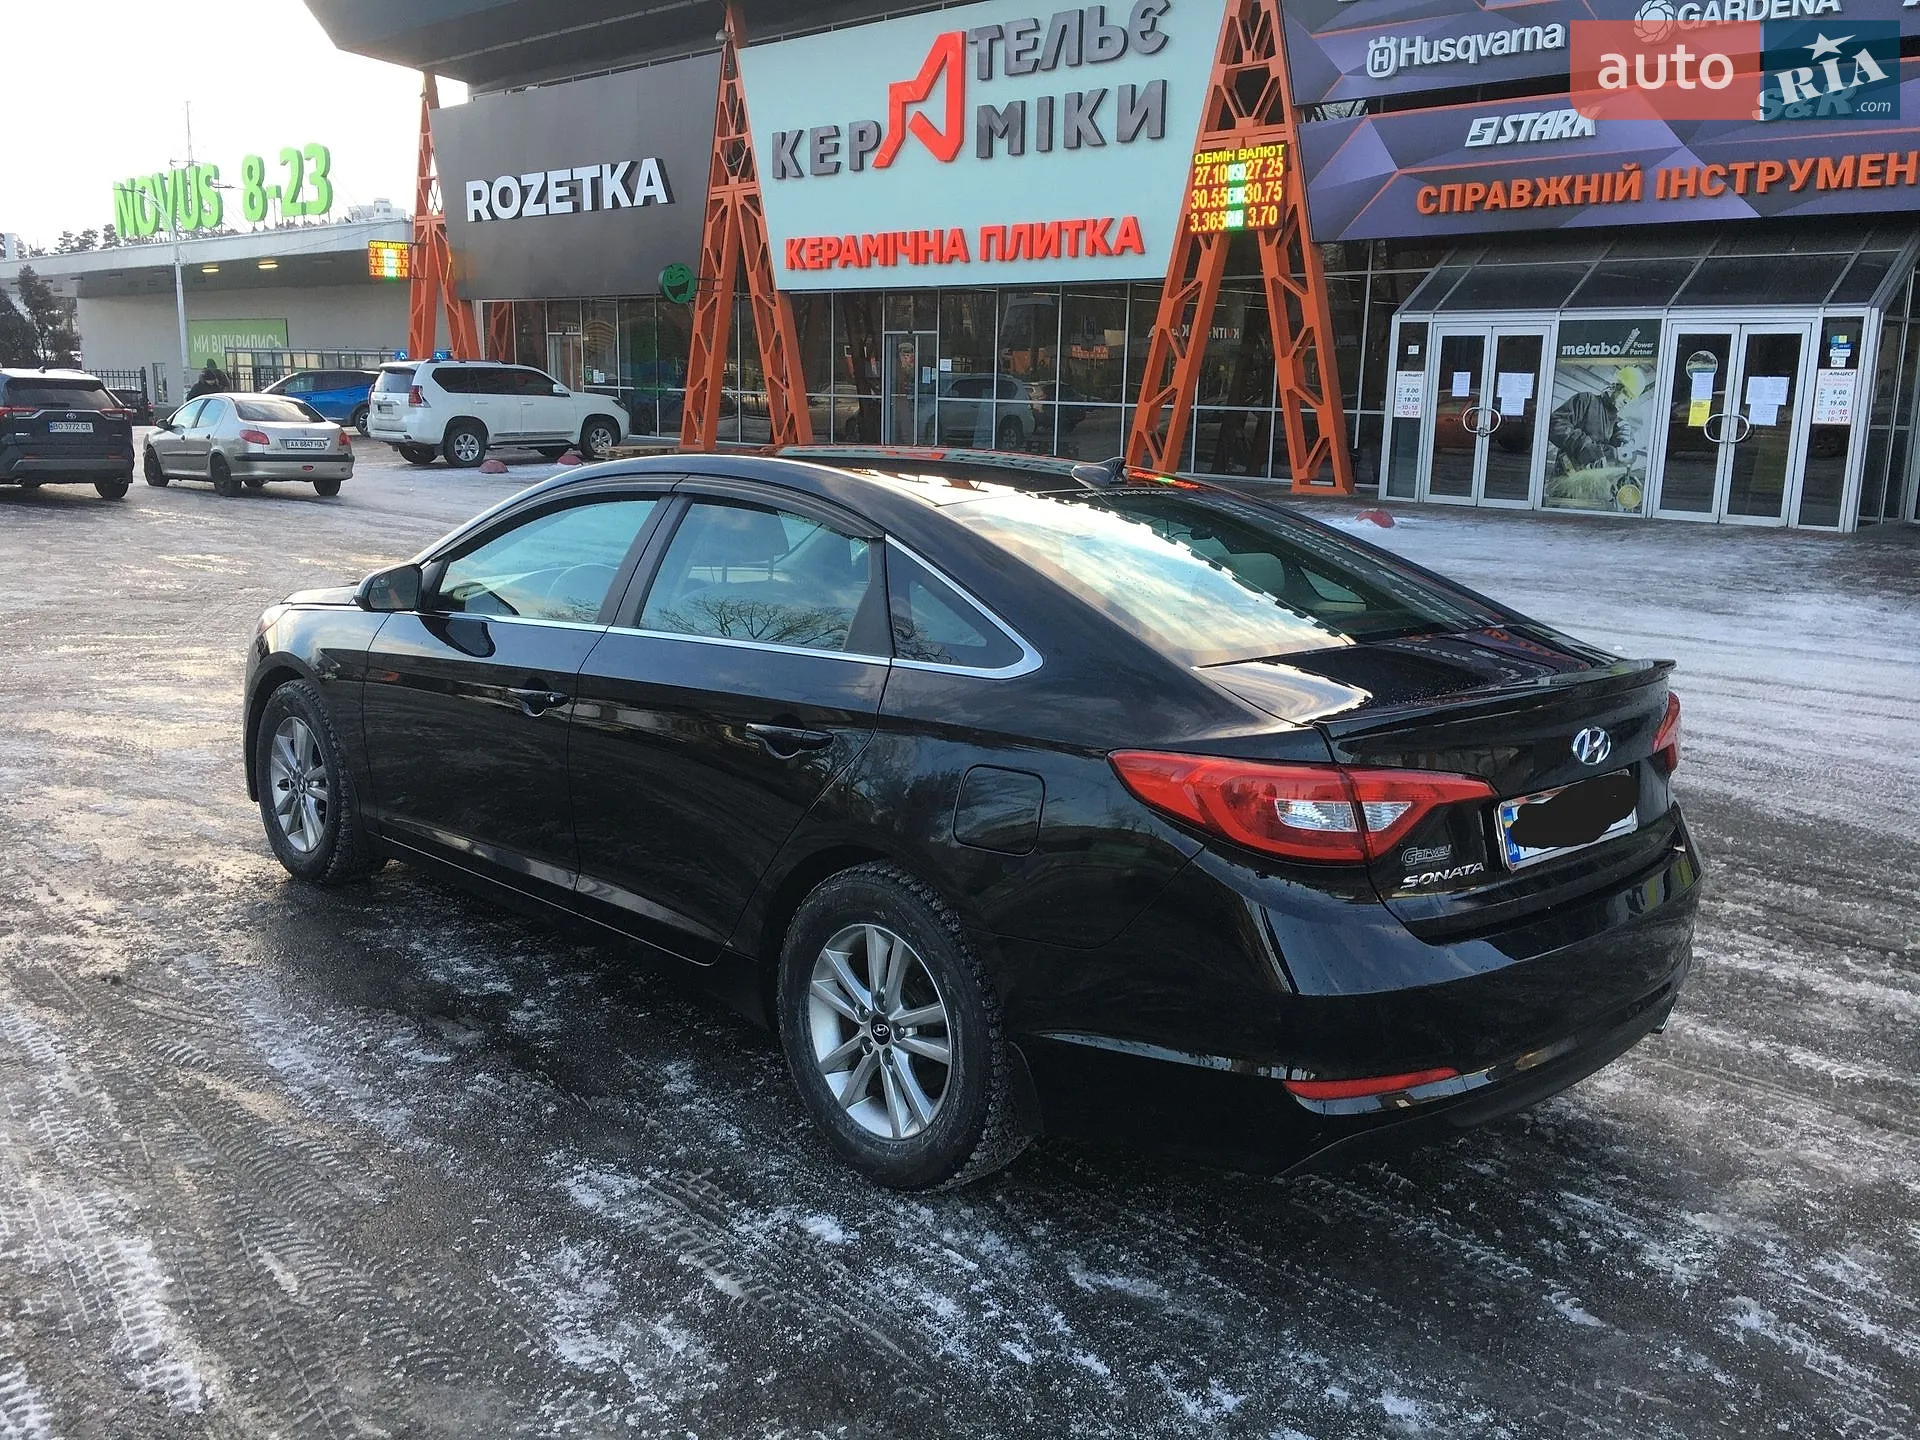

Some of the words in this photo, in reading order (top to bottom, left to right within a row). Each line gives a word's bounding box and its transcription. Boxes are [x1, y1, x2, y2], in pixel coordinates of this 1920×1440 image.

[1399, 23, 1565, 66] Husqvarna
[1496, 106, 1602, 145] STARK
[1194, 150, 1235, 165] ОБМІН
[1238, 144, 1285, 161] ВАЛЮТ
[1194, 163, 1228, 186] 27.10
[1245, 156, 1284, 180] 27.25
[112, 164, 224, 239] NOVUS
[241, 142, 334, 223] 8-23
[465, 157, 674, 222] ROZETKA
[1191, 187, 1227, 210] 30.55
[1244, 180, 1283, 204] 30.75
[1416, 163, 1642, 215] СПРАВЖНІЙ
[1190, 210, 1226, 232] 3.365
[1247, 205, 1278, 227] 3.70
[785, 229, 969, 271] КЕРАМІЧНА
[978, 215, 1145, 261] ПЛИТКА
[193, 335, 209, 353] МИ
[1561, 342, 1621, 355] metabo
[1400, 862, 1485, 890] SONATA
